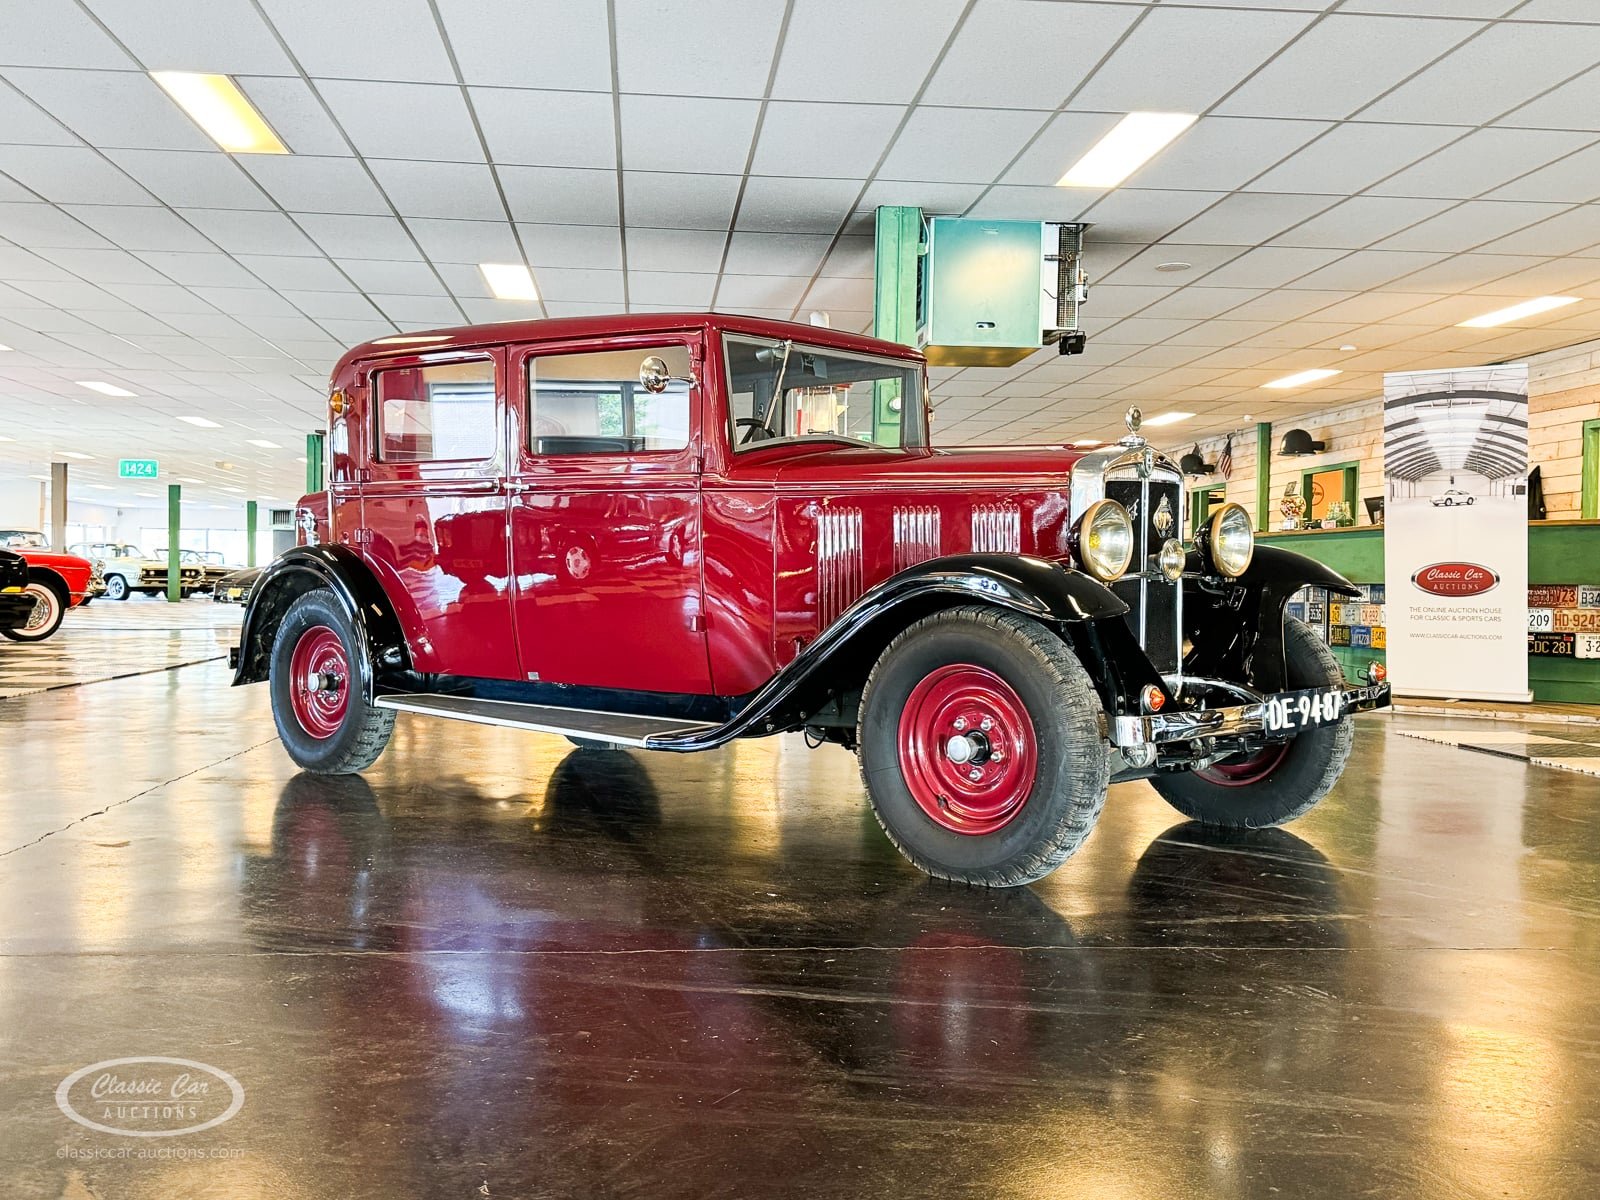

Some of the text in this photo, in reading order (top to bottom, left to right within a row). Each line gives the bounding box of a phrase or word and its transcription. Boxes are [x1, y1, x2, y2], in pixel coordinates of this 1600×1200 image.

[125, 463, 153, 474] 1424
[1427, 568, 1484, 580] Classic Car
[1552, 641, 1572, 654] 281
[1268, 690, 1342, 731] DE-94-87
